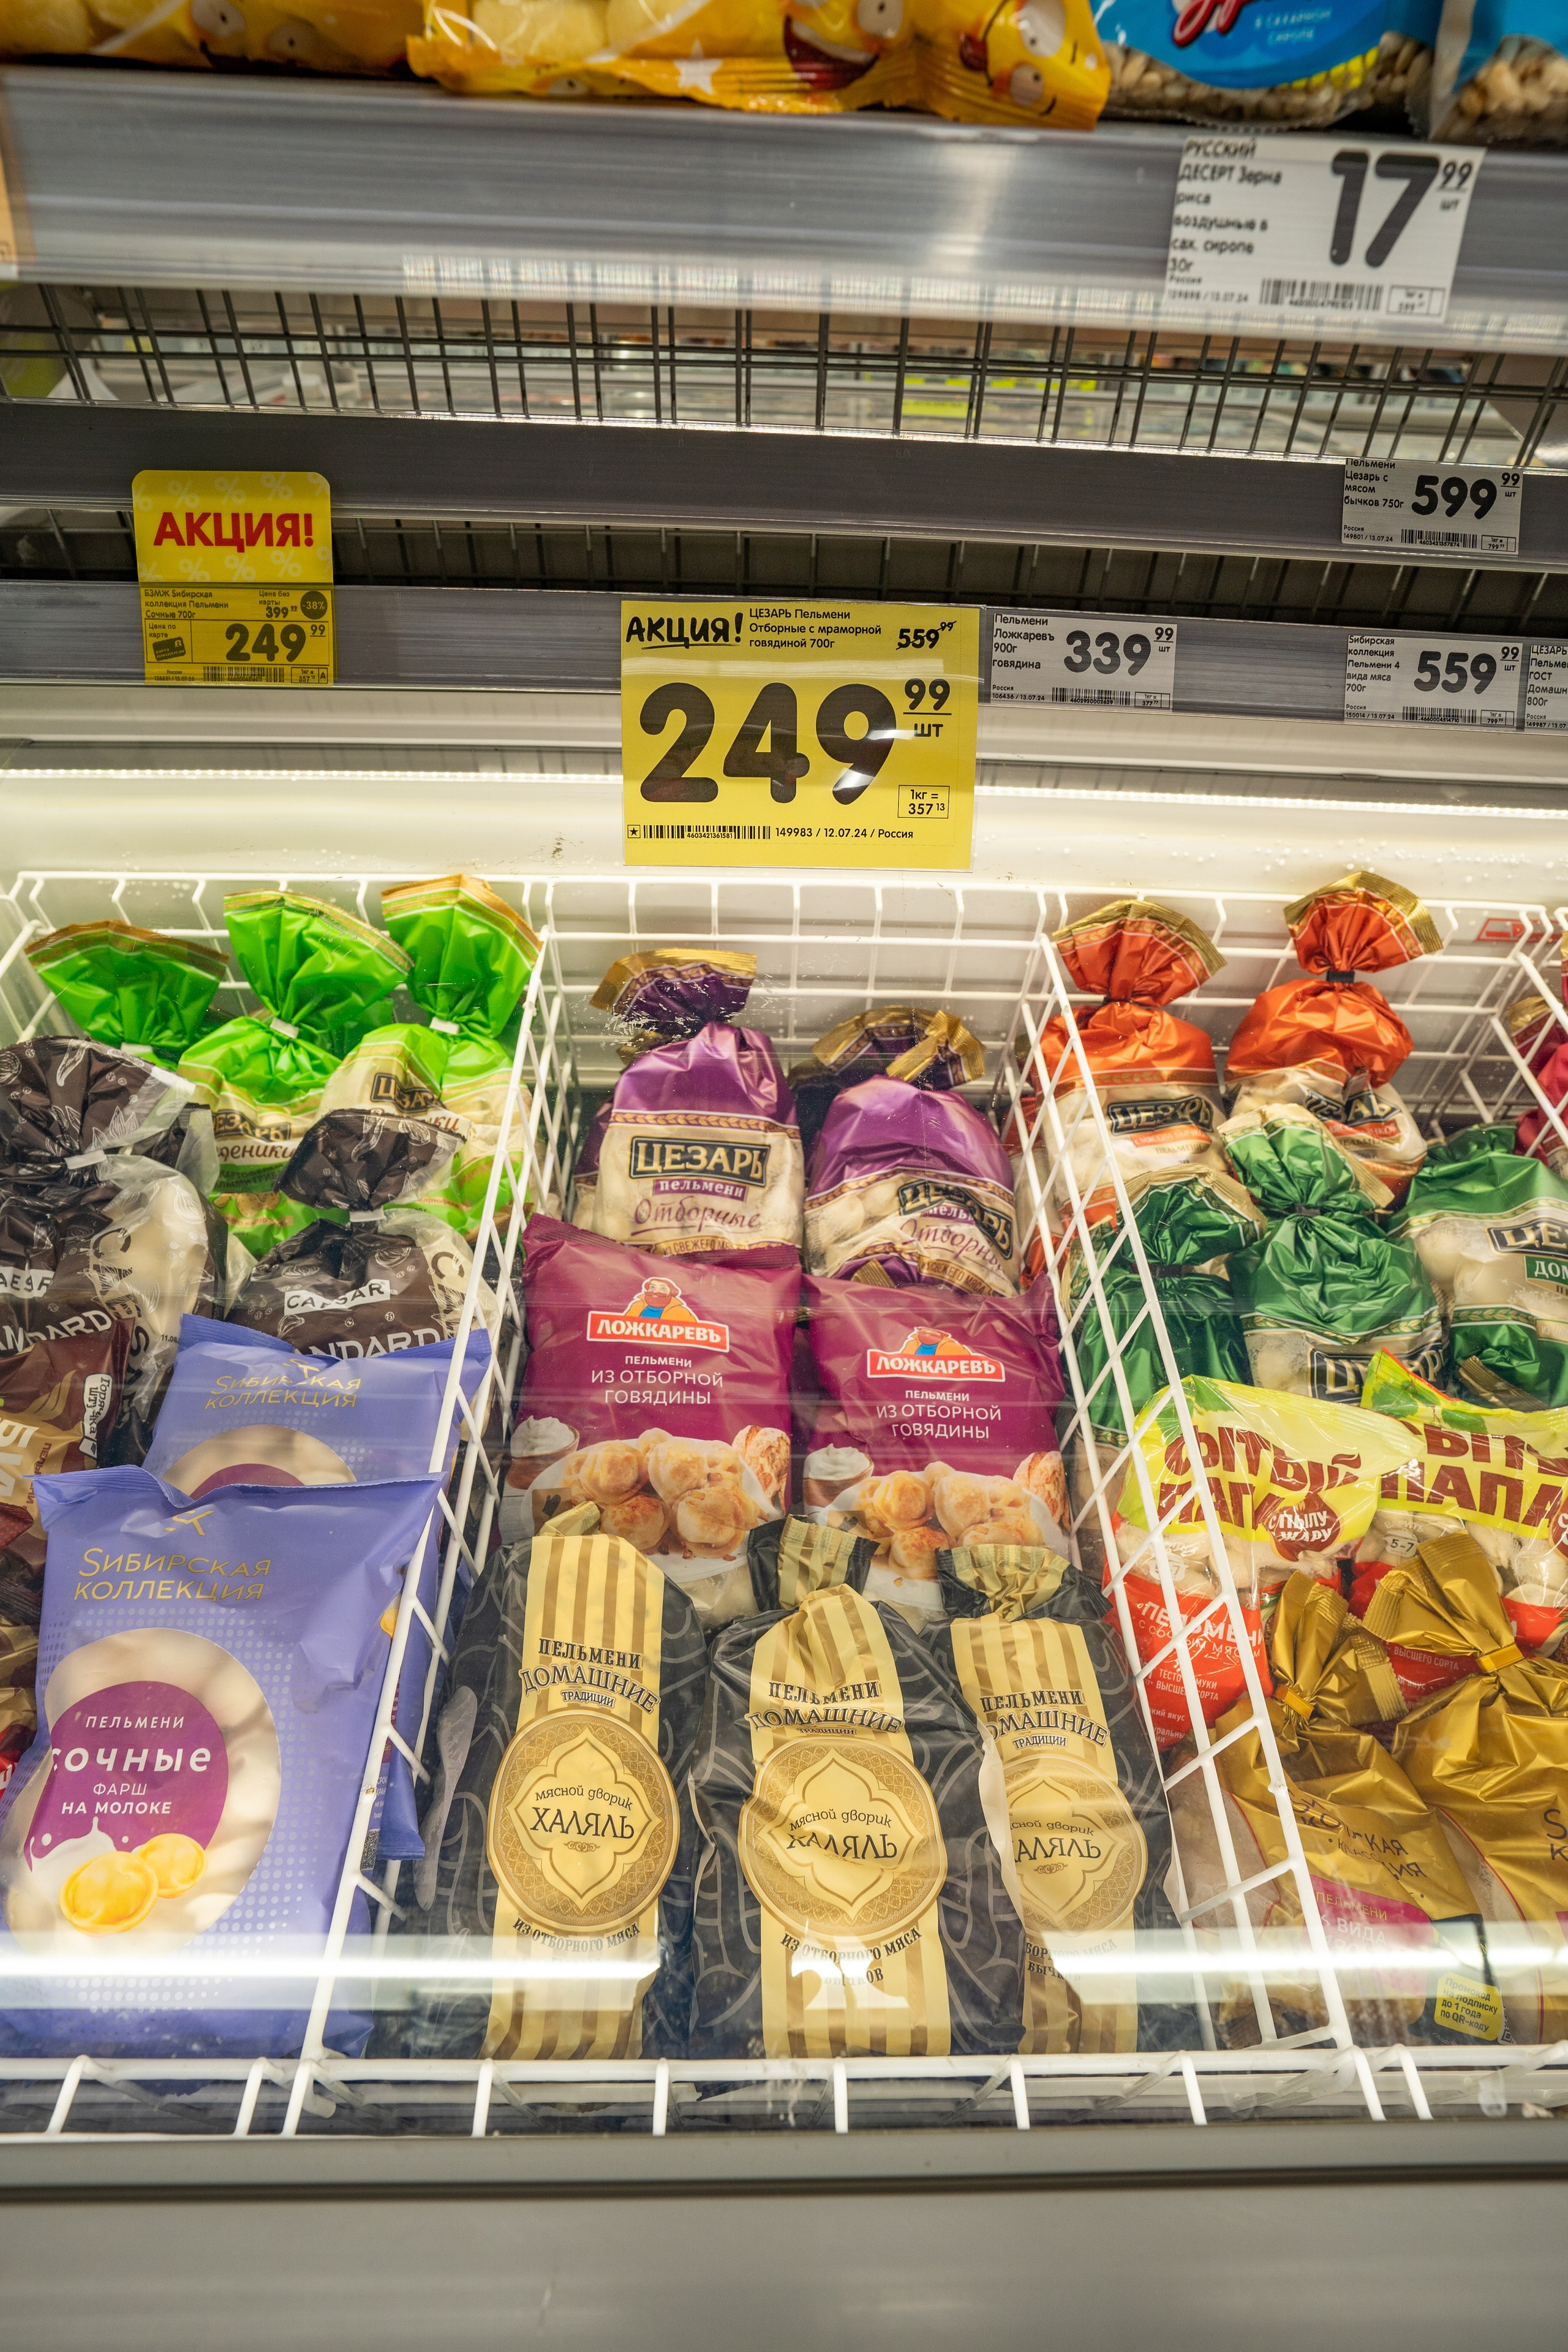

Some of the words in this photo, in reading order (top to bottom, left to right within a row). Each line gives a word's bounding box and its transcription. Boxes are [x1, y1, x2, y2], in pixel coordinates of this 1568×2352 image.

[1442, 160, 1472, 187] 99
[1330, 149, 1441, 268] 17
[1439, 198, 1460, 211] шт
[1346, 470, 1380, 482] Цезарь
[1501, 472, 1520, 486] 99
[1345, 484, 1375, 493] мясом
[1344, 496, 1379, 507] бычков
[1382, 499, 1404, 508] 750г
[1411, 475, 1497, 519] 599
[154, 512, 314, 553] АКЦИЯ!
[265, 606, 289, 619] 399
[302, 601, 326, 610] -38%
[146, 611, 176, 619] Сочные
[749, 608, 792, 620] ЦЕЗАРЬ
[795, 609, 851, 620] Пельмени
[995, 614, 1048, 625] Пельмени
[310, 624, 326, 635] 99
[625, 612, 744, 649] АКЦИЯ!
[749, 622, 805, 633] Отборные
[818, 624, 881, 636] мраморной
[993, 628, 1055, 641] Ложкаревъ
[1155, 627, 1174, 641] 99
[225, 623, 306, 662] 249
[749, 638, 807, 649] говядиной
[810, 638, 835, 648] 700г
[897, 628, 940, 649] 559
[993, 643, 1017, 654] 900г
[1064, 630, 1151, 676] 339
[1348, 649, 1395, 657] коллекция
[1501, 646, 1520, 660] 99
[1531, 646, 1567, 655] ЦЕЗАРЬ
[992, 659, 1041, 669] говядина
[1348, 660, 1392, 669] Пельмени
[1414, 650, 1497, 695] 559
[904, 678, 951, 711] 99
[1346, 684, 1366, 692] 700г
[1527, 697, 1548, 706] 800г
[913, 723, 943, 737] шт
[639, 682, 897, 805] 249
[910, 789, 927, 800] 1кг
[908, 804, 933, 815] 357
[775, 827, 812, 837] 149983
[824, 828, 867, 838] 12.07.24
[878, 829, 913, 839] Россия
[636, 1142, 765, 1179] ЦЕЗАРЬ
[660, 1180, 744, 1198] пельмени
[634, 1196, 761, 1232] Отборные
[597, 1319, 721, 1343] ЛОЖКАРЕВЪ
[625, 1356, 692, 1368] ПЕЛЬМЕНИ
[876, 1356, 995, 1374] ЛОЖКАРЕВЪ
[592, 1370, 614, 1383] ИЗ
[620, 1370, 723, 1387] ОТБОРНОЙ
[204, 1389, 358, 1410] КОЛЛЕКЦИЯ
[605, 1390, 710, 1406] ГОВЯДИНЫ
[905, 1390, 970, 1401] ПЕЛЬМЕНИ
[876, 1406, 897, 1418] ИЗ
[902, 1404, 1001, 1420] ОТБОРНОЙ
[891, 1423, 989, 1439] ГОВЯДИНЫ
[1390, 1539, 1414, 1553] 5-7
[74, 1580, 265, 1602] КОЛЛЕКЦИЯ
[538, 1638, 642, 1670] ПЕЛЬМЕНИ
[1394, 1646, 1432, 1664] ВЫСШЕГО
[1434, 1657, 1458, 1670] СОРТА
[521, 1665, 659, 1714] ДОМАШНИЕ
[769, 1681, 880, 1705] ПЕЛЬМЕНИ
[562, 1691, 614, 1708] ТРАДИЦИИ
[980, 1691, 1083, 1713] ПЕЛЬМЕНИ
[85, 1716, 184, 1729] ПЕЛЬМЕНИ
[747, 1708, 903, 1733] ДОМАШНИЕ
[1013, 1736, 1066, 1749] ТРАДИЦИИ
[93, 1783, 147, 1796] ФАРШ
[535, 1785, 584, 1801] мясной
[589, 1789, 633, 1811] дворик
[62, 1801, 88, 1814] НА
[95, 1801, 172, 1814] МОЛОКЕ
[530, 1806, 635, 1839] ХАЛЯЛЬ
[790, 1809, 837, 1831] мясной
[842, 1809, 892, 1828] дворик
[1047, 1822, 1094, 1836] дворик
[786, 1832, 898, 1860] ХАЛЯЛЬ
[1316, 1891, 1387, 1921] ПЕЛЬМЕНИ
[512, 1917, 532, 1935] ИЗ
[532, 1928, 604, 1953] ОТБОРНОГО
[606, 1923, 641, 1949] МЯСА
[1337, 1917, 1386, 1946] ВИДА
[780, 1933, 800, 1951] ИЗ
[883, 1927, 922, 1957] МЯСА
[1446, 1977, 1491, 2002] Промокод
[1441, 1999, 1452, 2008] до
[1461, 2006, 1481, 2019] года
[1443, 1989, 1454, 1998] на
[1456, 1994, 1498, 2015] подписку
[1441, 2010, 1450, 2019] по
[1452, 2013, 1490, 2033] QR-коду
